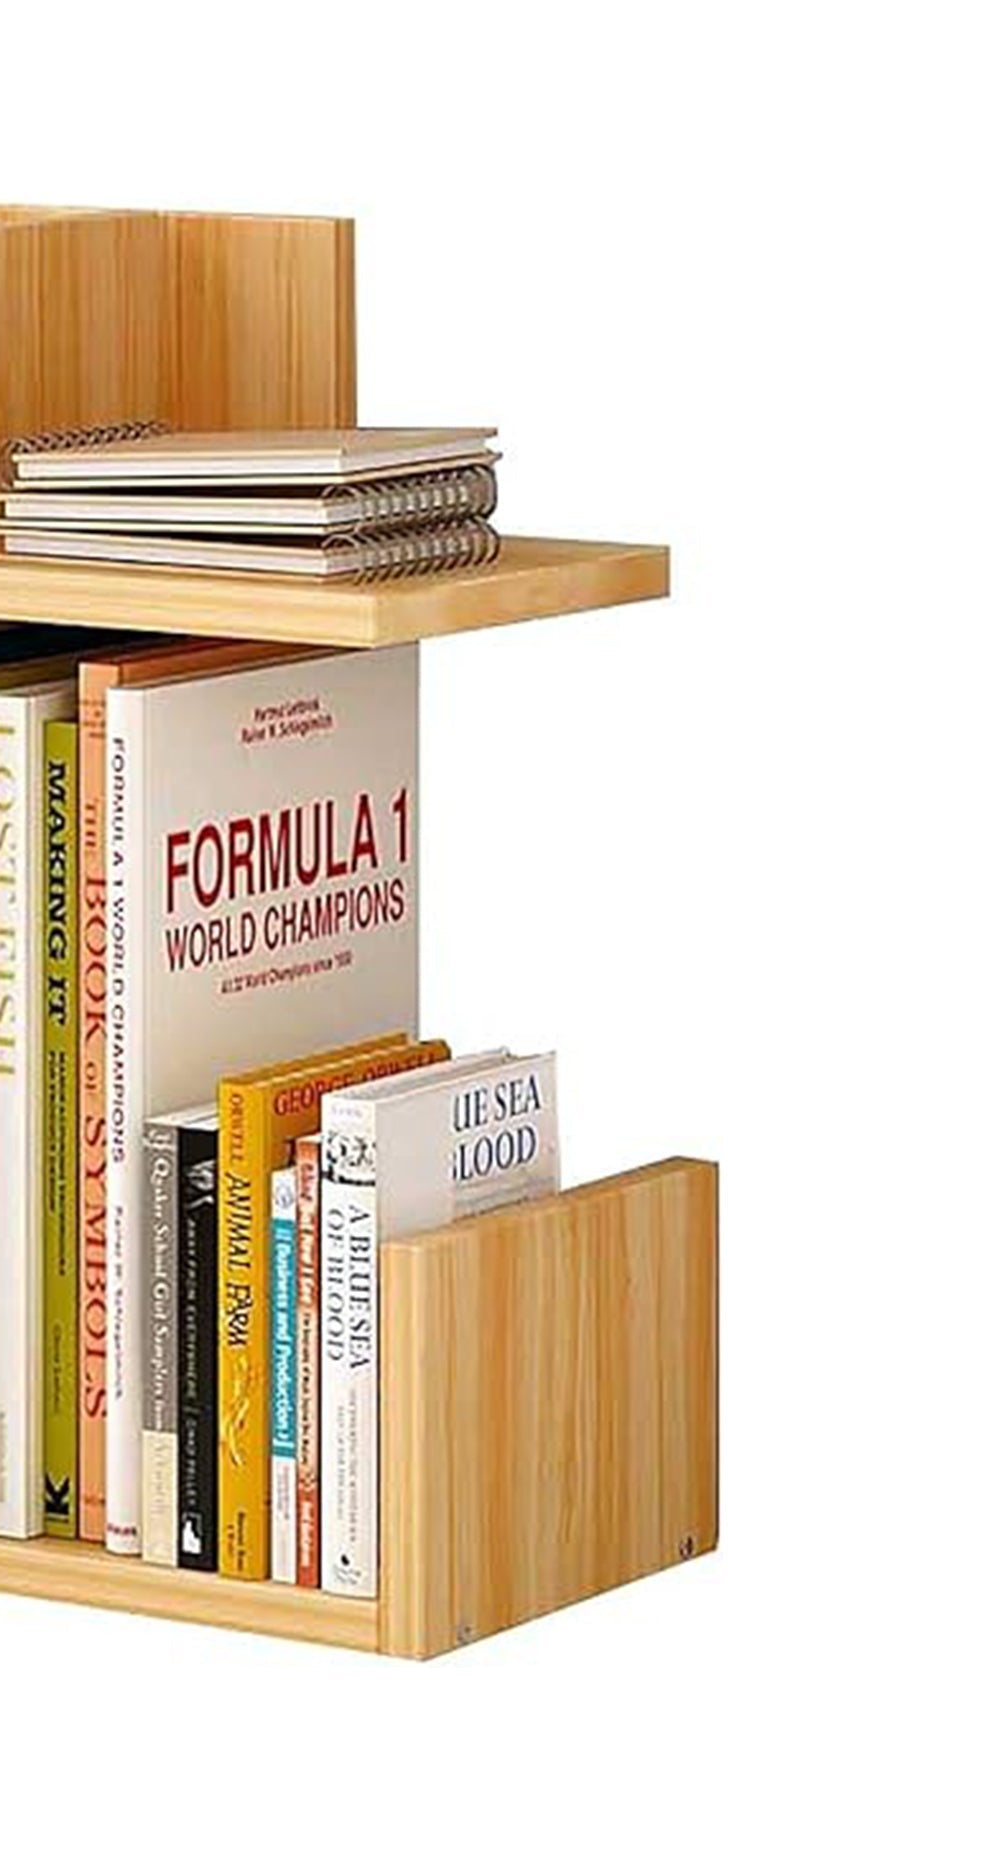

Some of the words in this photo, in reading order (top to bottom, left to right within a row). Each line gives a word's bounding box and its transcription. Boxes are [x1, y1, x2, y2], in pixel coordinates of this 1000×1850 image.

[112, 736, 124, 866] FORMULA
[47, 761, 66, 962] MAKING
[113, 878, 124, 887] 1
[167, 793, 379, 914] FORMULA
[393, 786, 407, 863] 1
[84, 874, 106, 1043] BOOK
[112, 899, 124, 997] WORLD
[166, 911, 257, 972] WORLD
[263, 878, 405, 950] CHAMPIONS
[47, 974, 66, 1025] IT
[112, 1003, 125, 1163] CHAMPIONS
[494, 1074, 542, 1122] SEA
[230, 1091, 243, 1163] ORWELL
[452, 1125, 537, 1180] LOOD
[225, 1172, 253, 1272] ANIMAL
[326, 1208, 345, 1250] OF
[348, 1204, 372, 1225] A
[84, 1113, 106, 1419] SYMBOLS
[275, 1242, 292, 1309] Business
[348, 1233, 373, 1312] BLUE
[226, 1281, 253, 1347] FARM
[275, 1311, 292, 1342] and
[326, 1255, 345, 1362] BLOOD
[348, 1315, 373, 1369] SEA
[275, 1343, 292, 1433] Production
